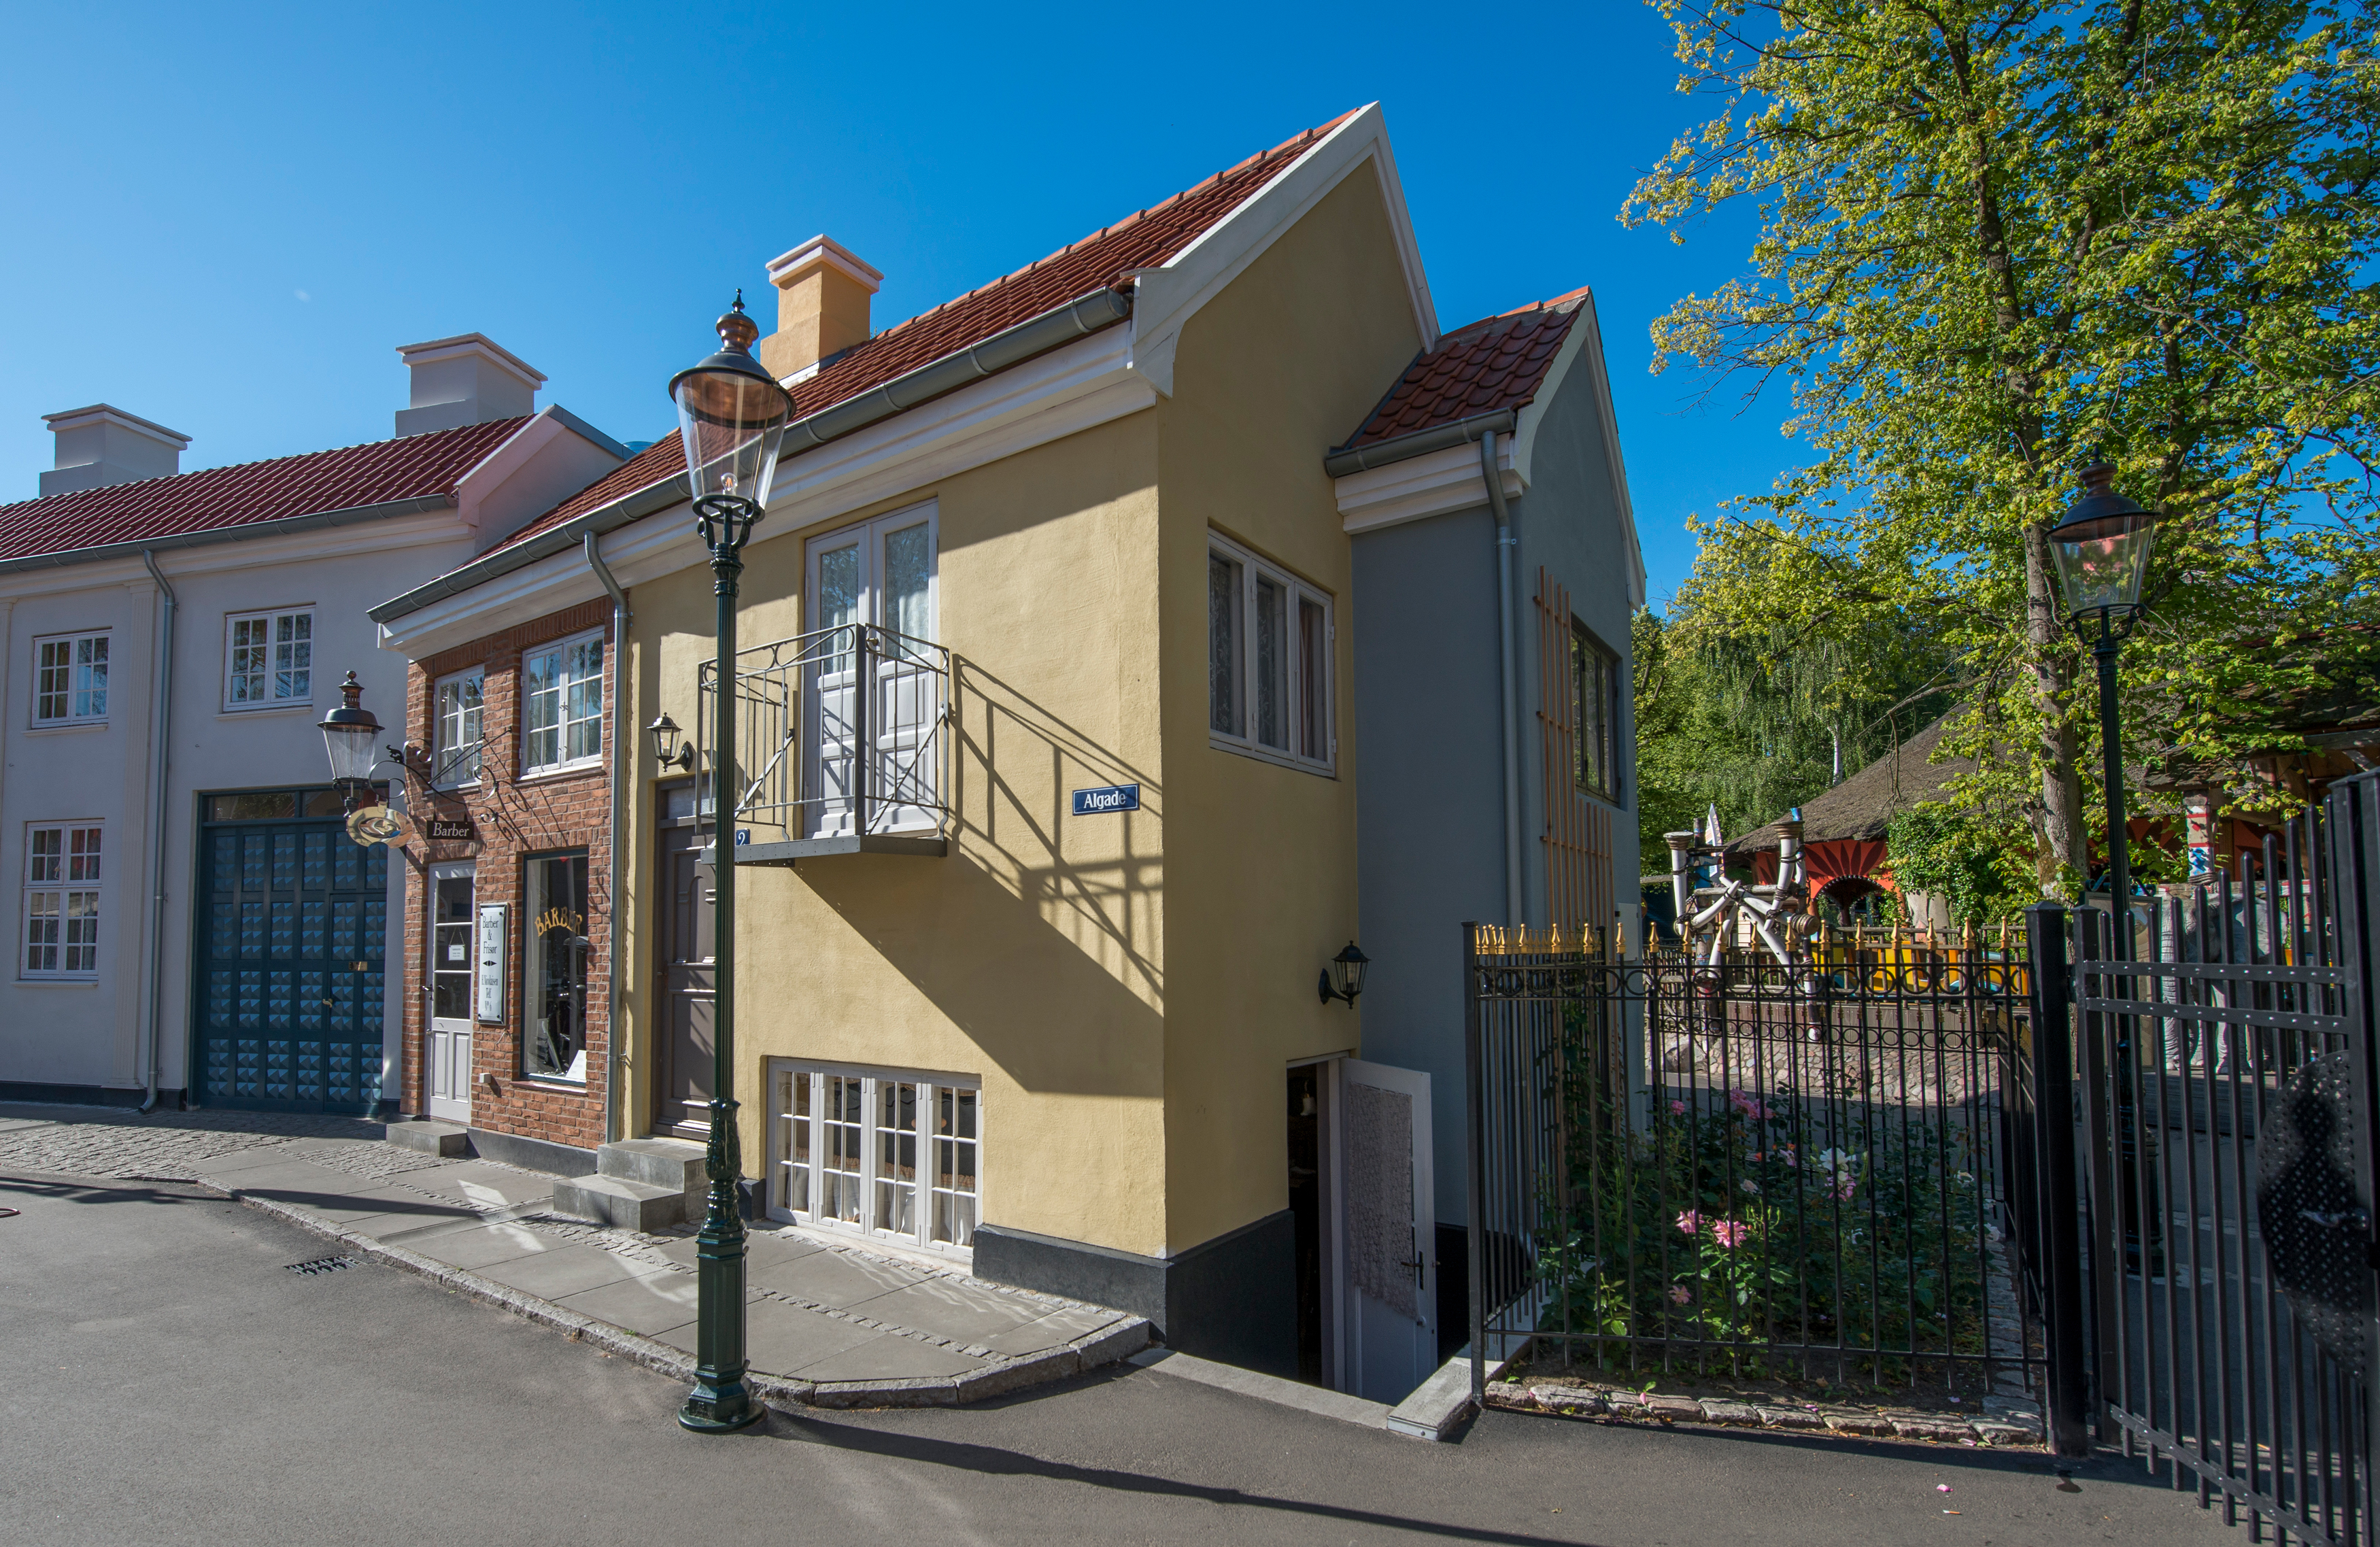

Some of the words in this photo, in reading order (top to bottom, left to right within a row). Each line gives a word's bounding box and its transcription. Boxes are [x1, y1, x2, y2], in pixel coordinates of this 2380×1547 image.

[1083, 791, 1126, 809] Algade
[432, 821, 469, 836] Barber
[483, 916, 498, 928] Barber
[534, 906, 583, 937] BARBER
[487, 929, 492, 940] &
